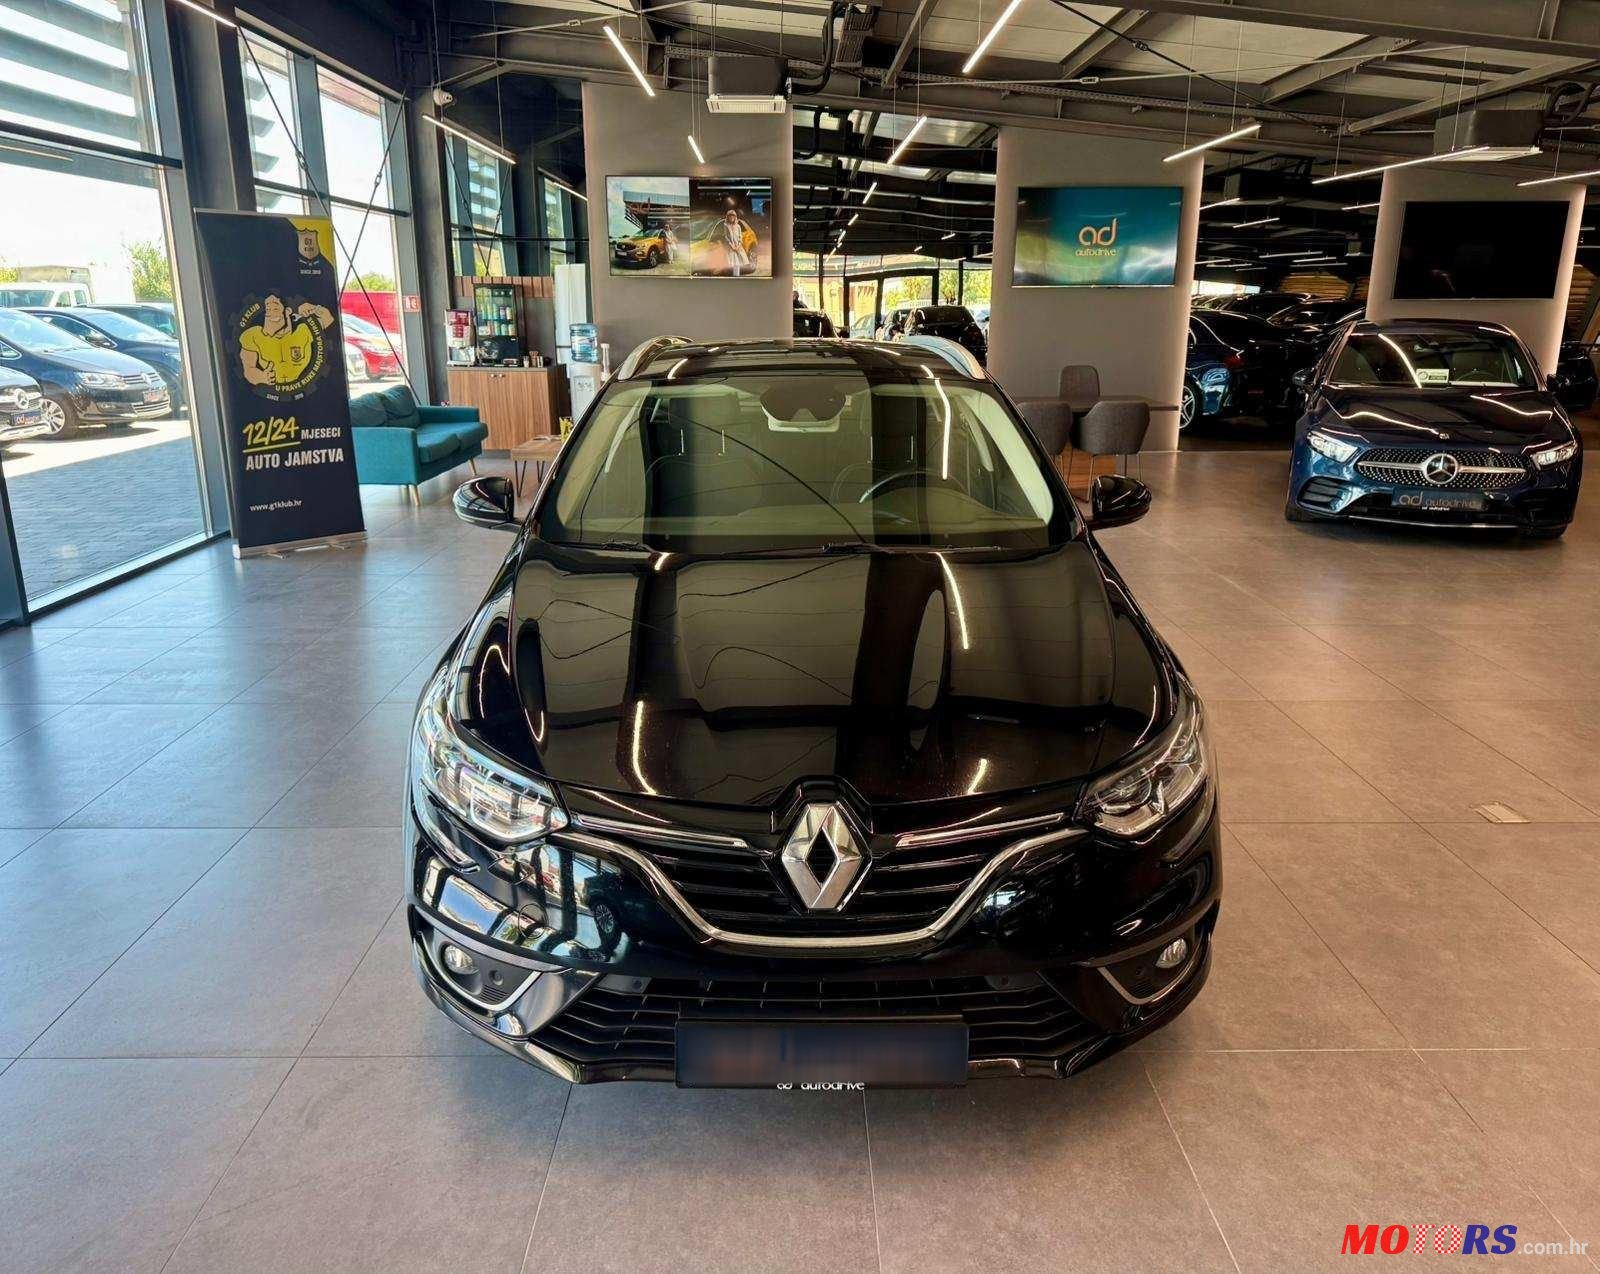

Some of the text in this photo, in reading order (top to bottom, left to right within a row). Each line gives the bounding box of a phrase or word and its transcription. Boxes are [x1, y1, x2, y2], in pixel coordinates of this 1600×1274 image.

[1079, 218, 1117, 246] ad
[245, 303, 261, 319] KLUB
[281, 381, 302, 392] PRAVE
[301, 371, 316, 386] RUKE
[312, 335, 324, 373] MAJSTORA
[242, 416, 341, 445] 12/24 MJESECI
[246, 448, 344, 471] AUTO JAMSTVA
[249, 500, 302, 511] www.g1klub.hr
[1399, 491, 1423, 506] ad
